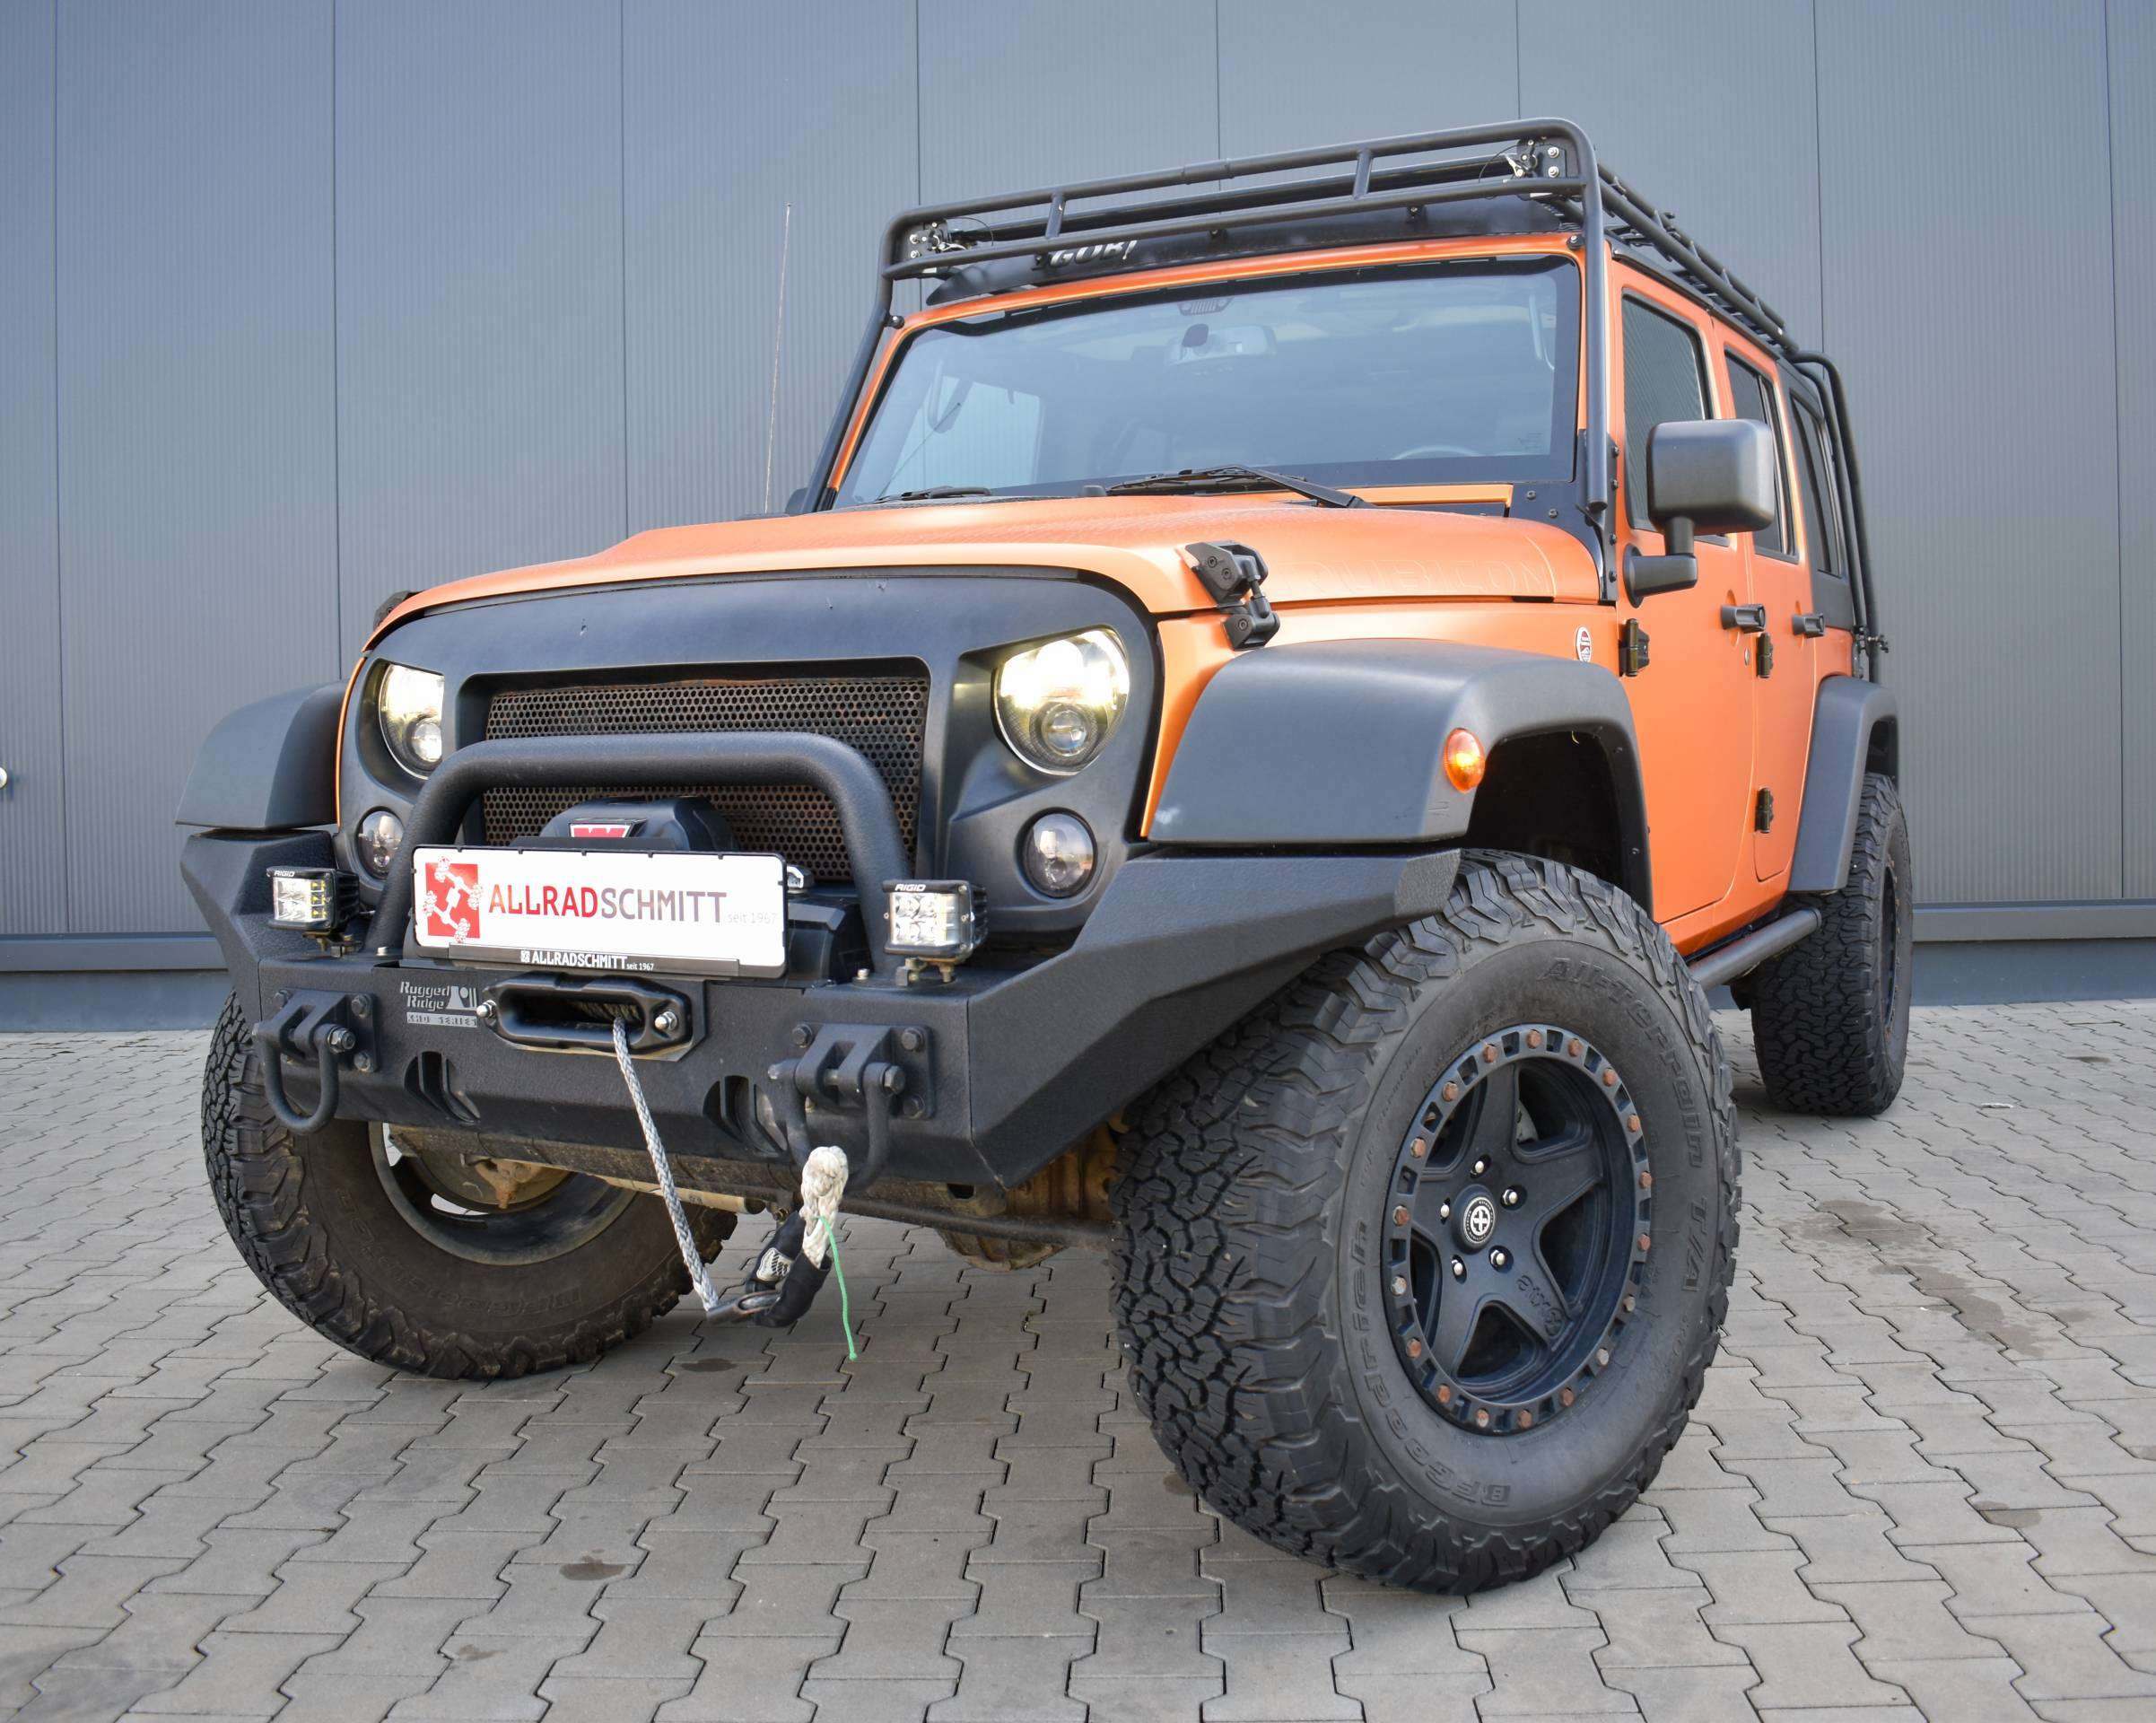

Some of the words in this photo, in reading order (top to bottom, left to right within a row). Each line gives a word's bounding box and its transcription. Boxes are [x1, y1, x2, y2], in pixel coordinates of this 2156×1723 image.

[273, 870, 296, 878] RIGID
[895, 883, 927, 892] RIGID
[488, 884, 728, 923] ALLRADSCHMITT
[728, 911, 747, 924] seit
[750, 911, 778, 925] 1967
[532, 951, 627, 970] ALLRADSCHMITT
[626, 962, 638, 970] seit
[639, 962, 655, 972] 1967
[400, 980, 450, 999] Rugged
[406, 995, 445, 1012] Ridge
[1536, 957, 1704, 1169] All-Terrain
[1349, 1218, 1511, 1507] BFGoodrich
